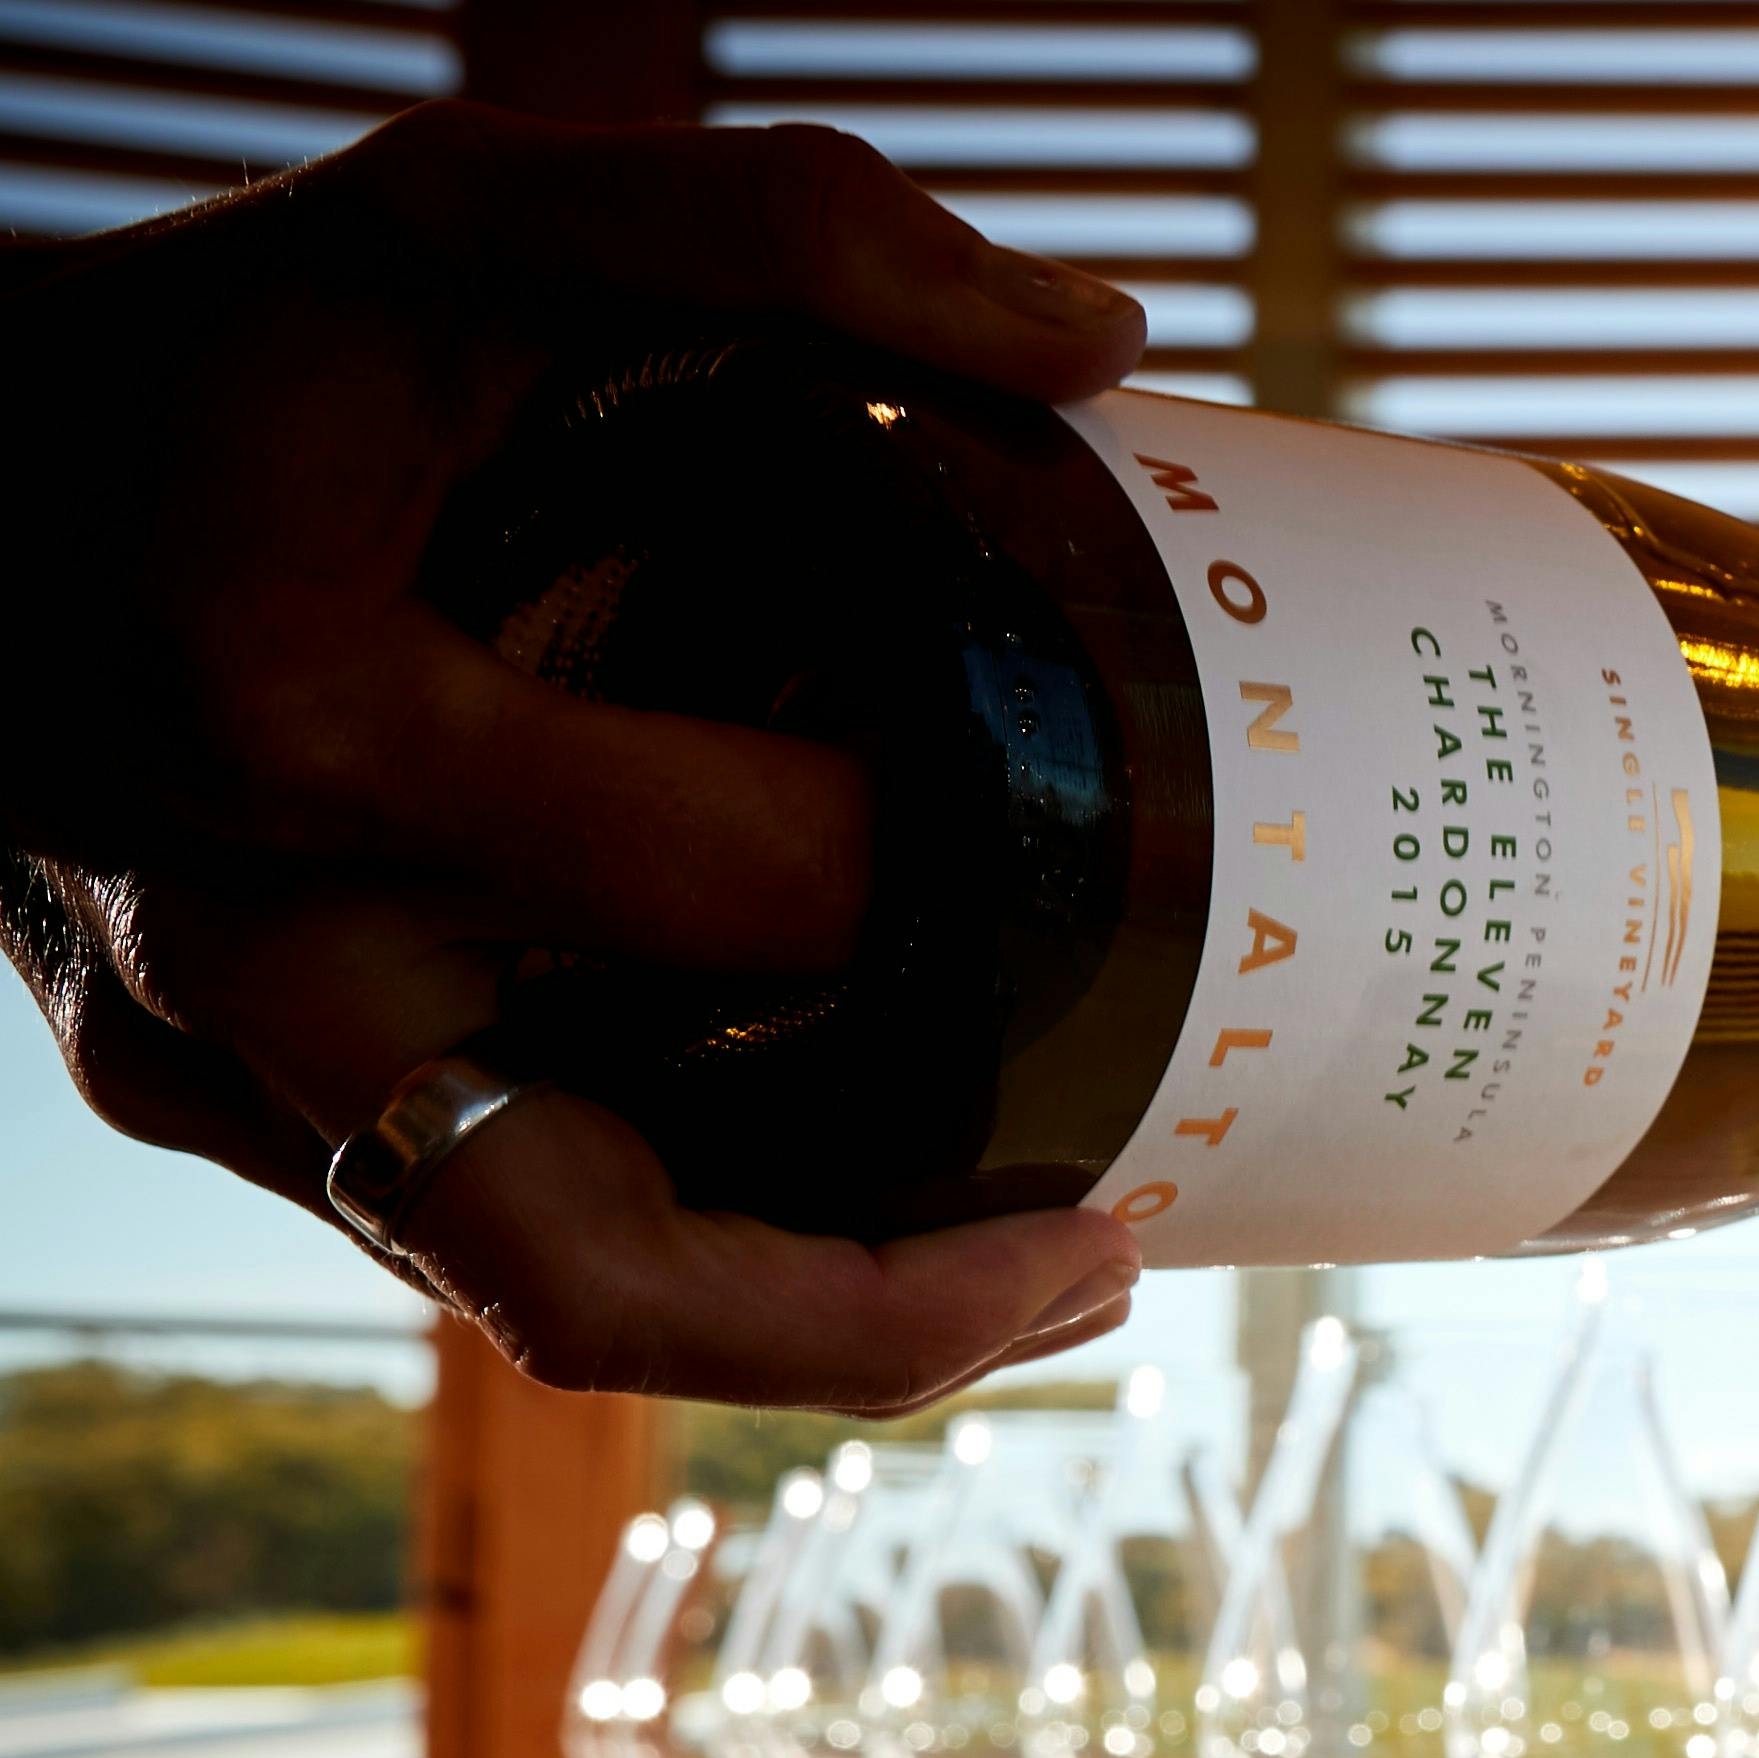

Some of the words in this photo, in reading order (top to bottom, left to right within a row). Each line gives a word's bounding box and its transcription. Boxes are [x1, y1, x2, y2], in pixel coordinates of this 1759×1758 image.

[1467, 663, 1514, 783] THE
[1484, 599, 1552, 897] MORNINGTON
[1601, 667, 1647, 834] SINGLE
[1111, 451, 1307, 1224] MONTALTO
[1384, 625, 1470, 1111] CHARDONNAY
[1384, 784, 1421, 956] 2015
[1443, 834, 1517, 1081] ELEVEN
[1453, 925, 1547, 1143] PENINSULA
[1583, 863, 1649, 1087] VINEYARD
